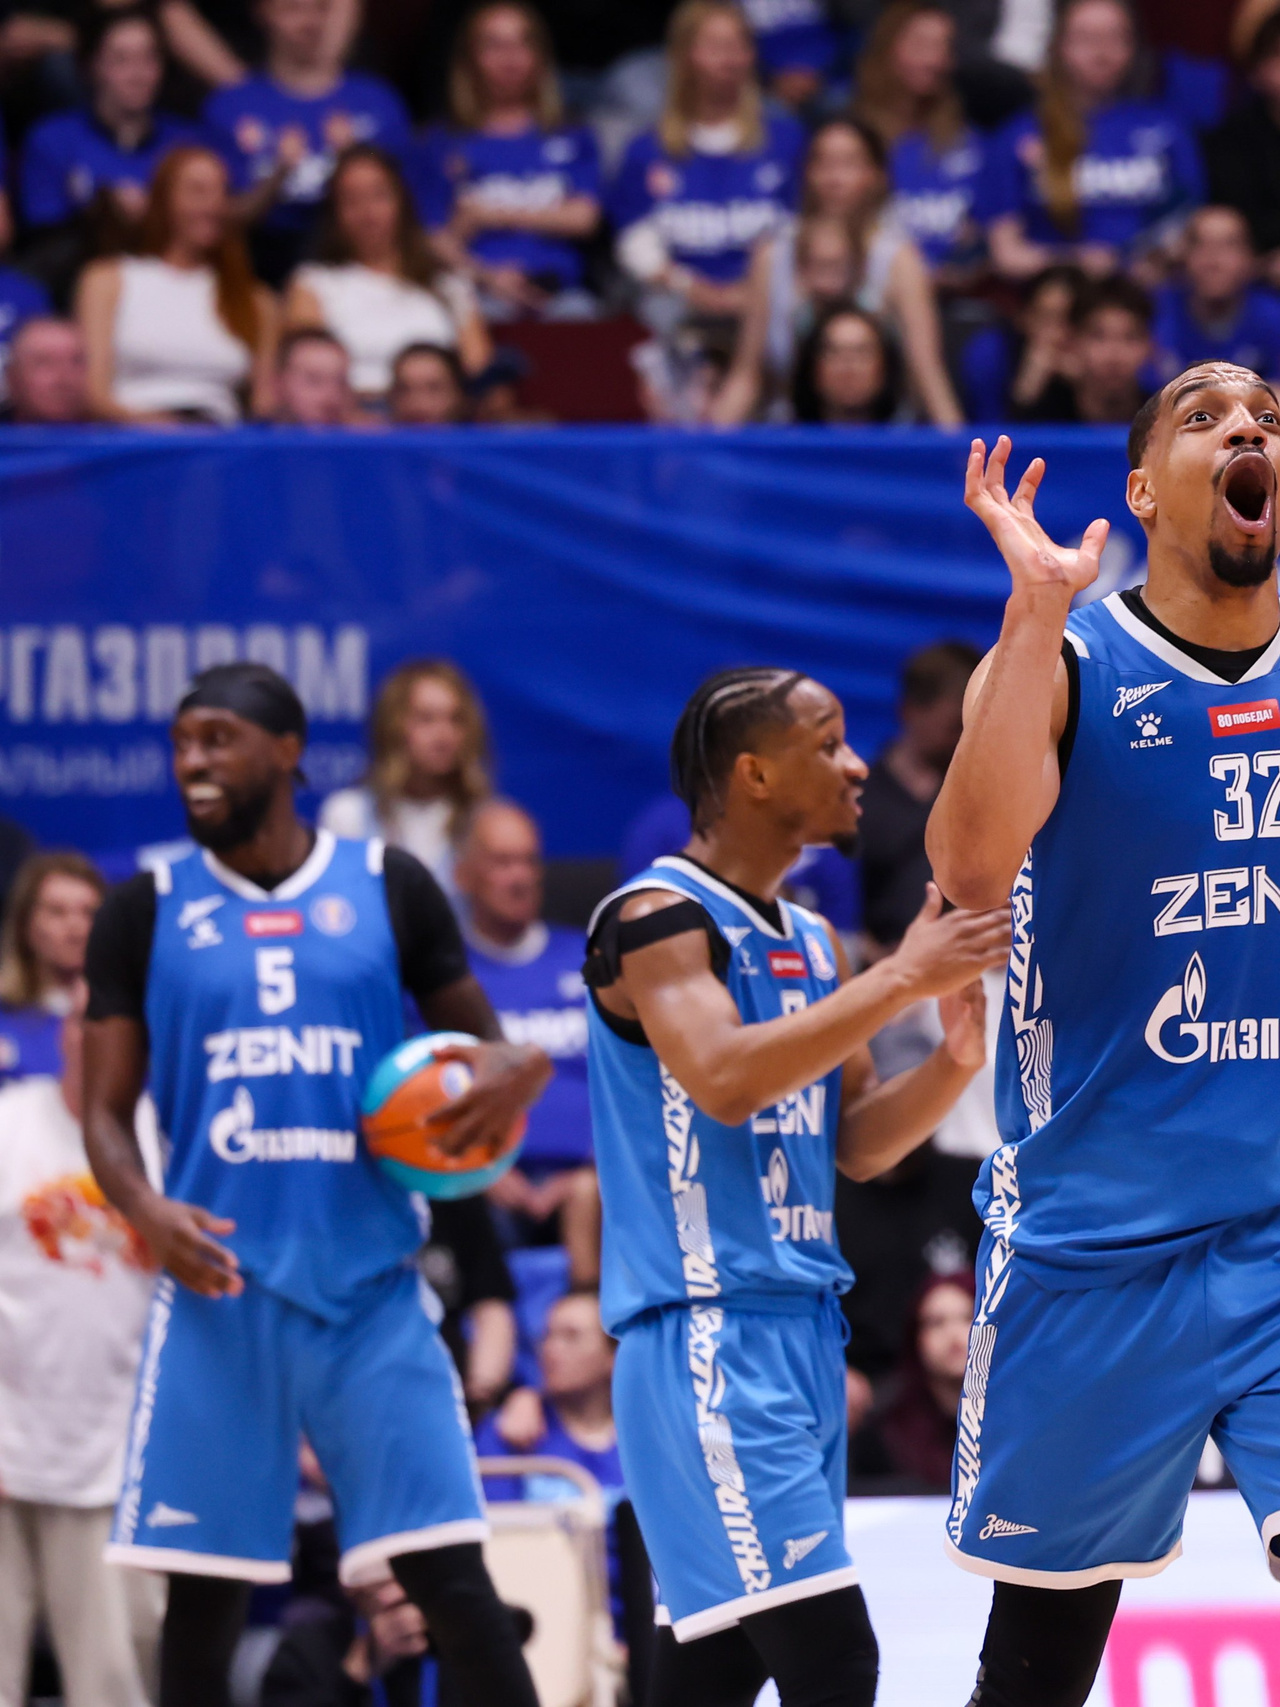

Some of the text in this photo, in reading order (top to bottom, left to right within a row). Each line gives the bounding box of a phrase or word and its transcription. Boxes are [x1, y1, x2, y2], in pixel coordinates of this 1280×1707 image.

[1217, 708, 1274, 729] 80 ПОБЕДА!
[1130, 735, 1174, 750] KELME
[254, 945, 297, 1016] 5
[203, 1024, 363, 1084] ZENIT
